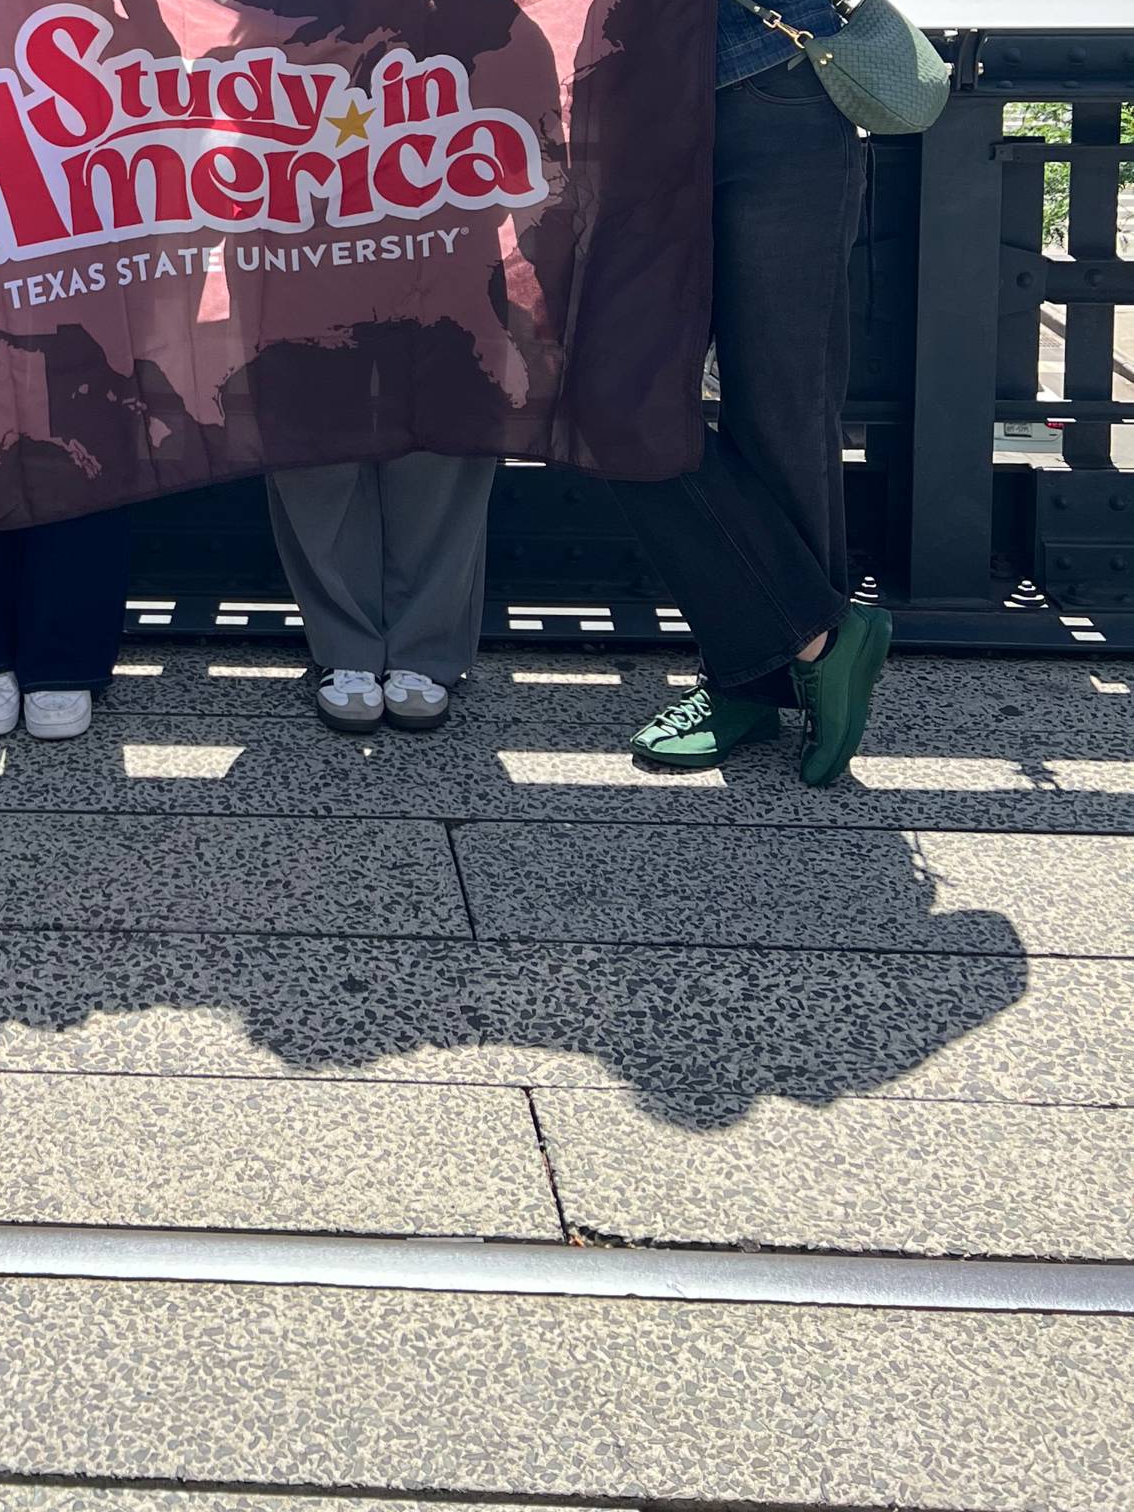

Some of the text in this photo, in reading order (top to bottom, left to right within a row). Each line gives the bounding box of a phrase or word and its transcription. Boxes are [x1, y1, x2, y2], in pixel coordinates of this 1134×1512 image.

[26, 15, 458, 148] Study in
[3, 262, 107, 310] TEXAS
[115, 246, 224, 286] STATE
